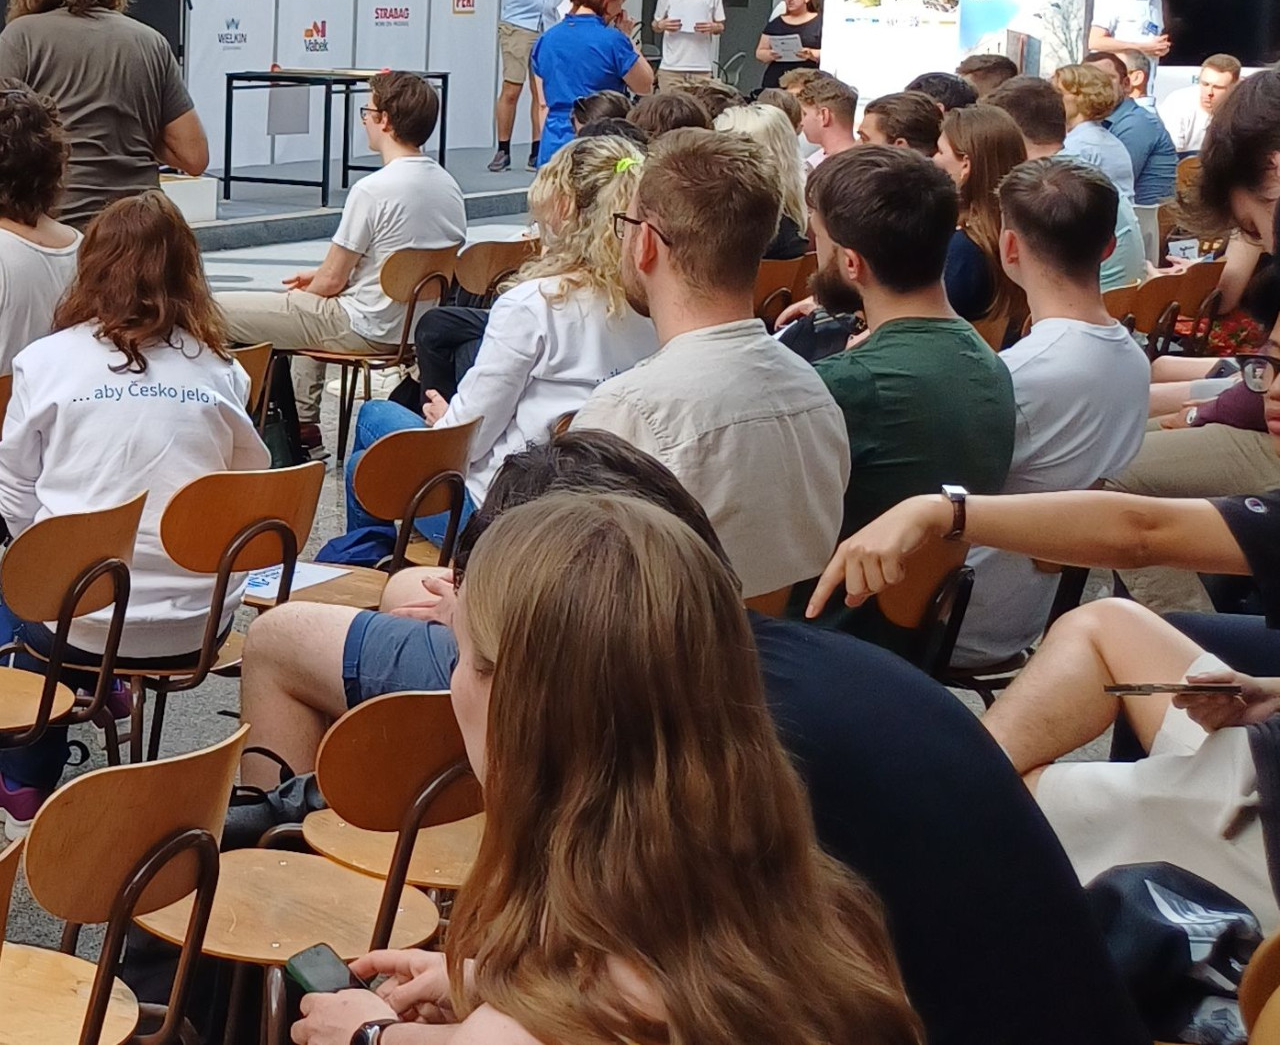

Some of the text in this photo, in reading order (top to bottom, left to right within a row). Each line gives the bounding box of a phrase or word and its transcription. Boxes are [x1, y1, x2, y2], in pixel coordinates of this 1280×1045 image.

[374, 8, 409, 19] STRABAG
[217, 33, 248, 44] WELKIN
[94, 384, 124, 402] aby
[128, 380, 178, 398] Česko
[180, 386, 210, 403] jelo
